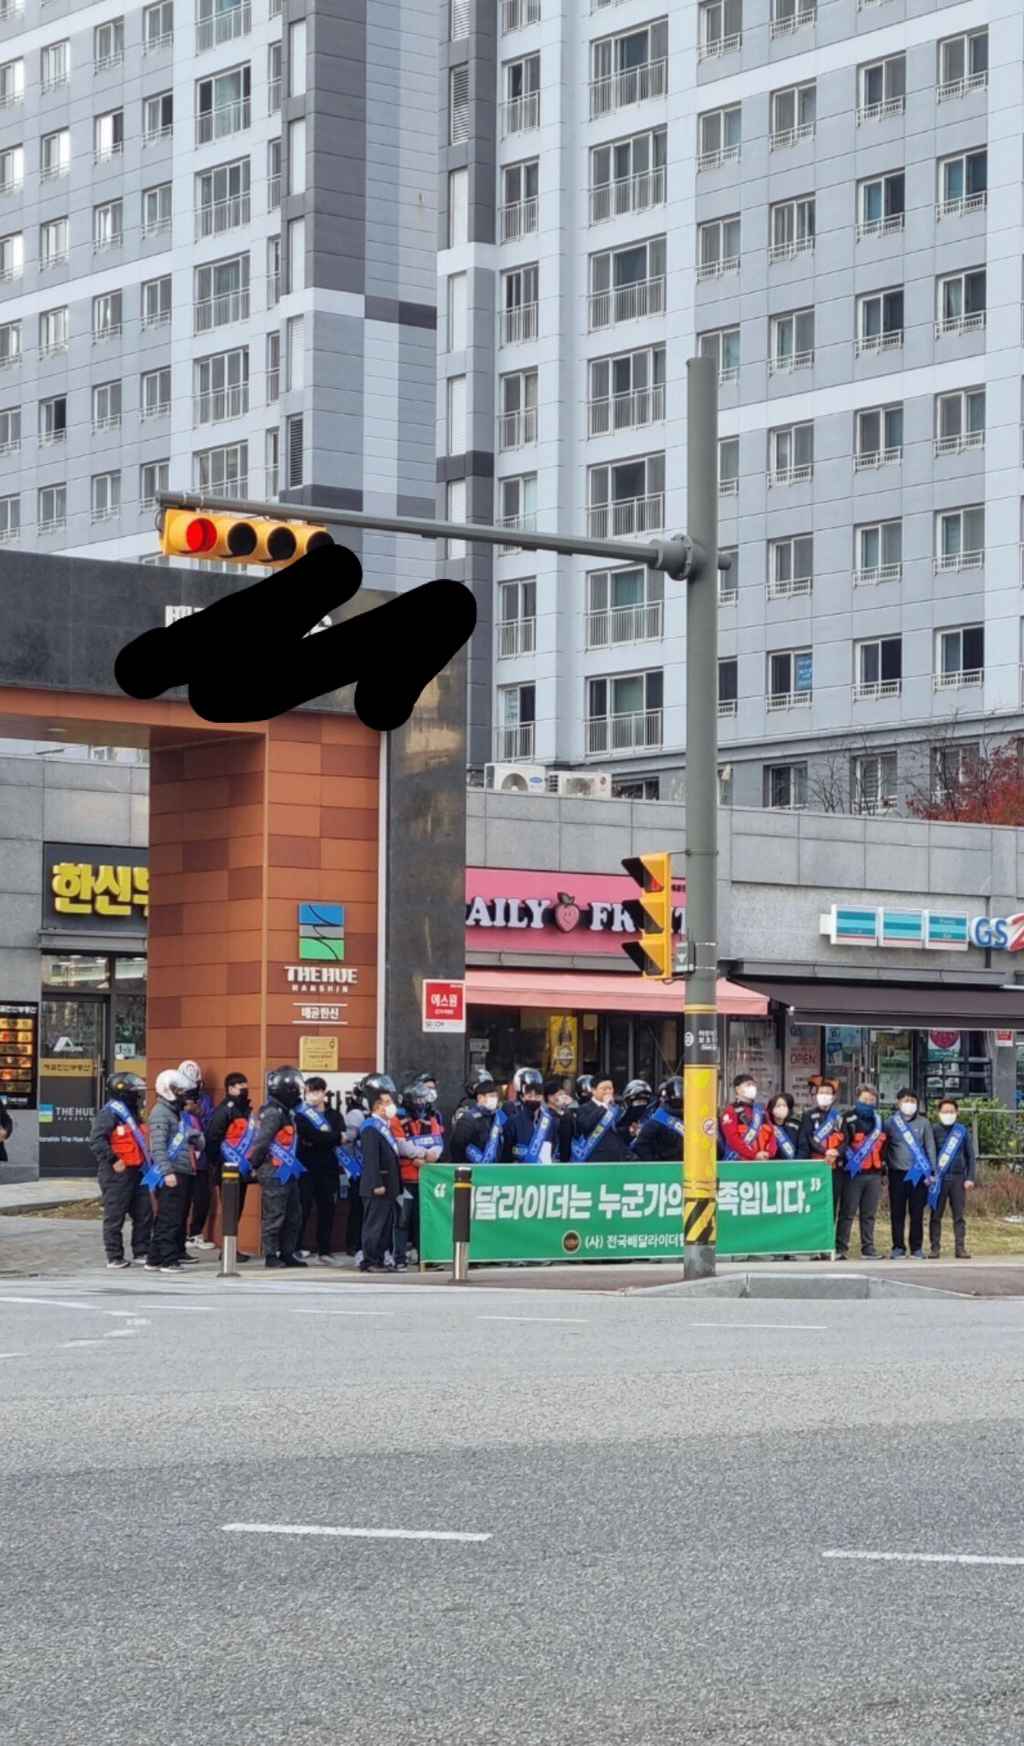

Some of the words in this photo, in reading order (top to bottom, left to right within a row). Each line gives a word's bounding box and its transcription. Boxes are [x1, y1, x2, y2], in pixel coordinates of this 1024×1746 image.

[466, 897, 550, 928] AILY
[292, 984, 349, 993] HANSHIN
[431, 993, 458, 1007] 에스원
[790, 1053, 816, 1065] OPEN
[434, 1184, 592, 1220] “달라이더는
[598, 1183, 684, 1219] 누군가의
[716, 1178, 821, 1217] 족입니다.”
[585, 1235, 604, 1249] (사)
